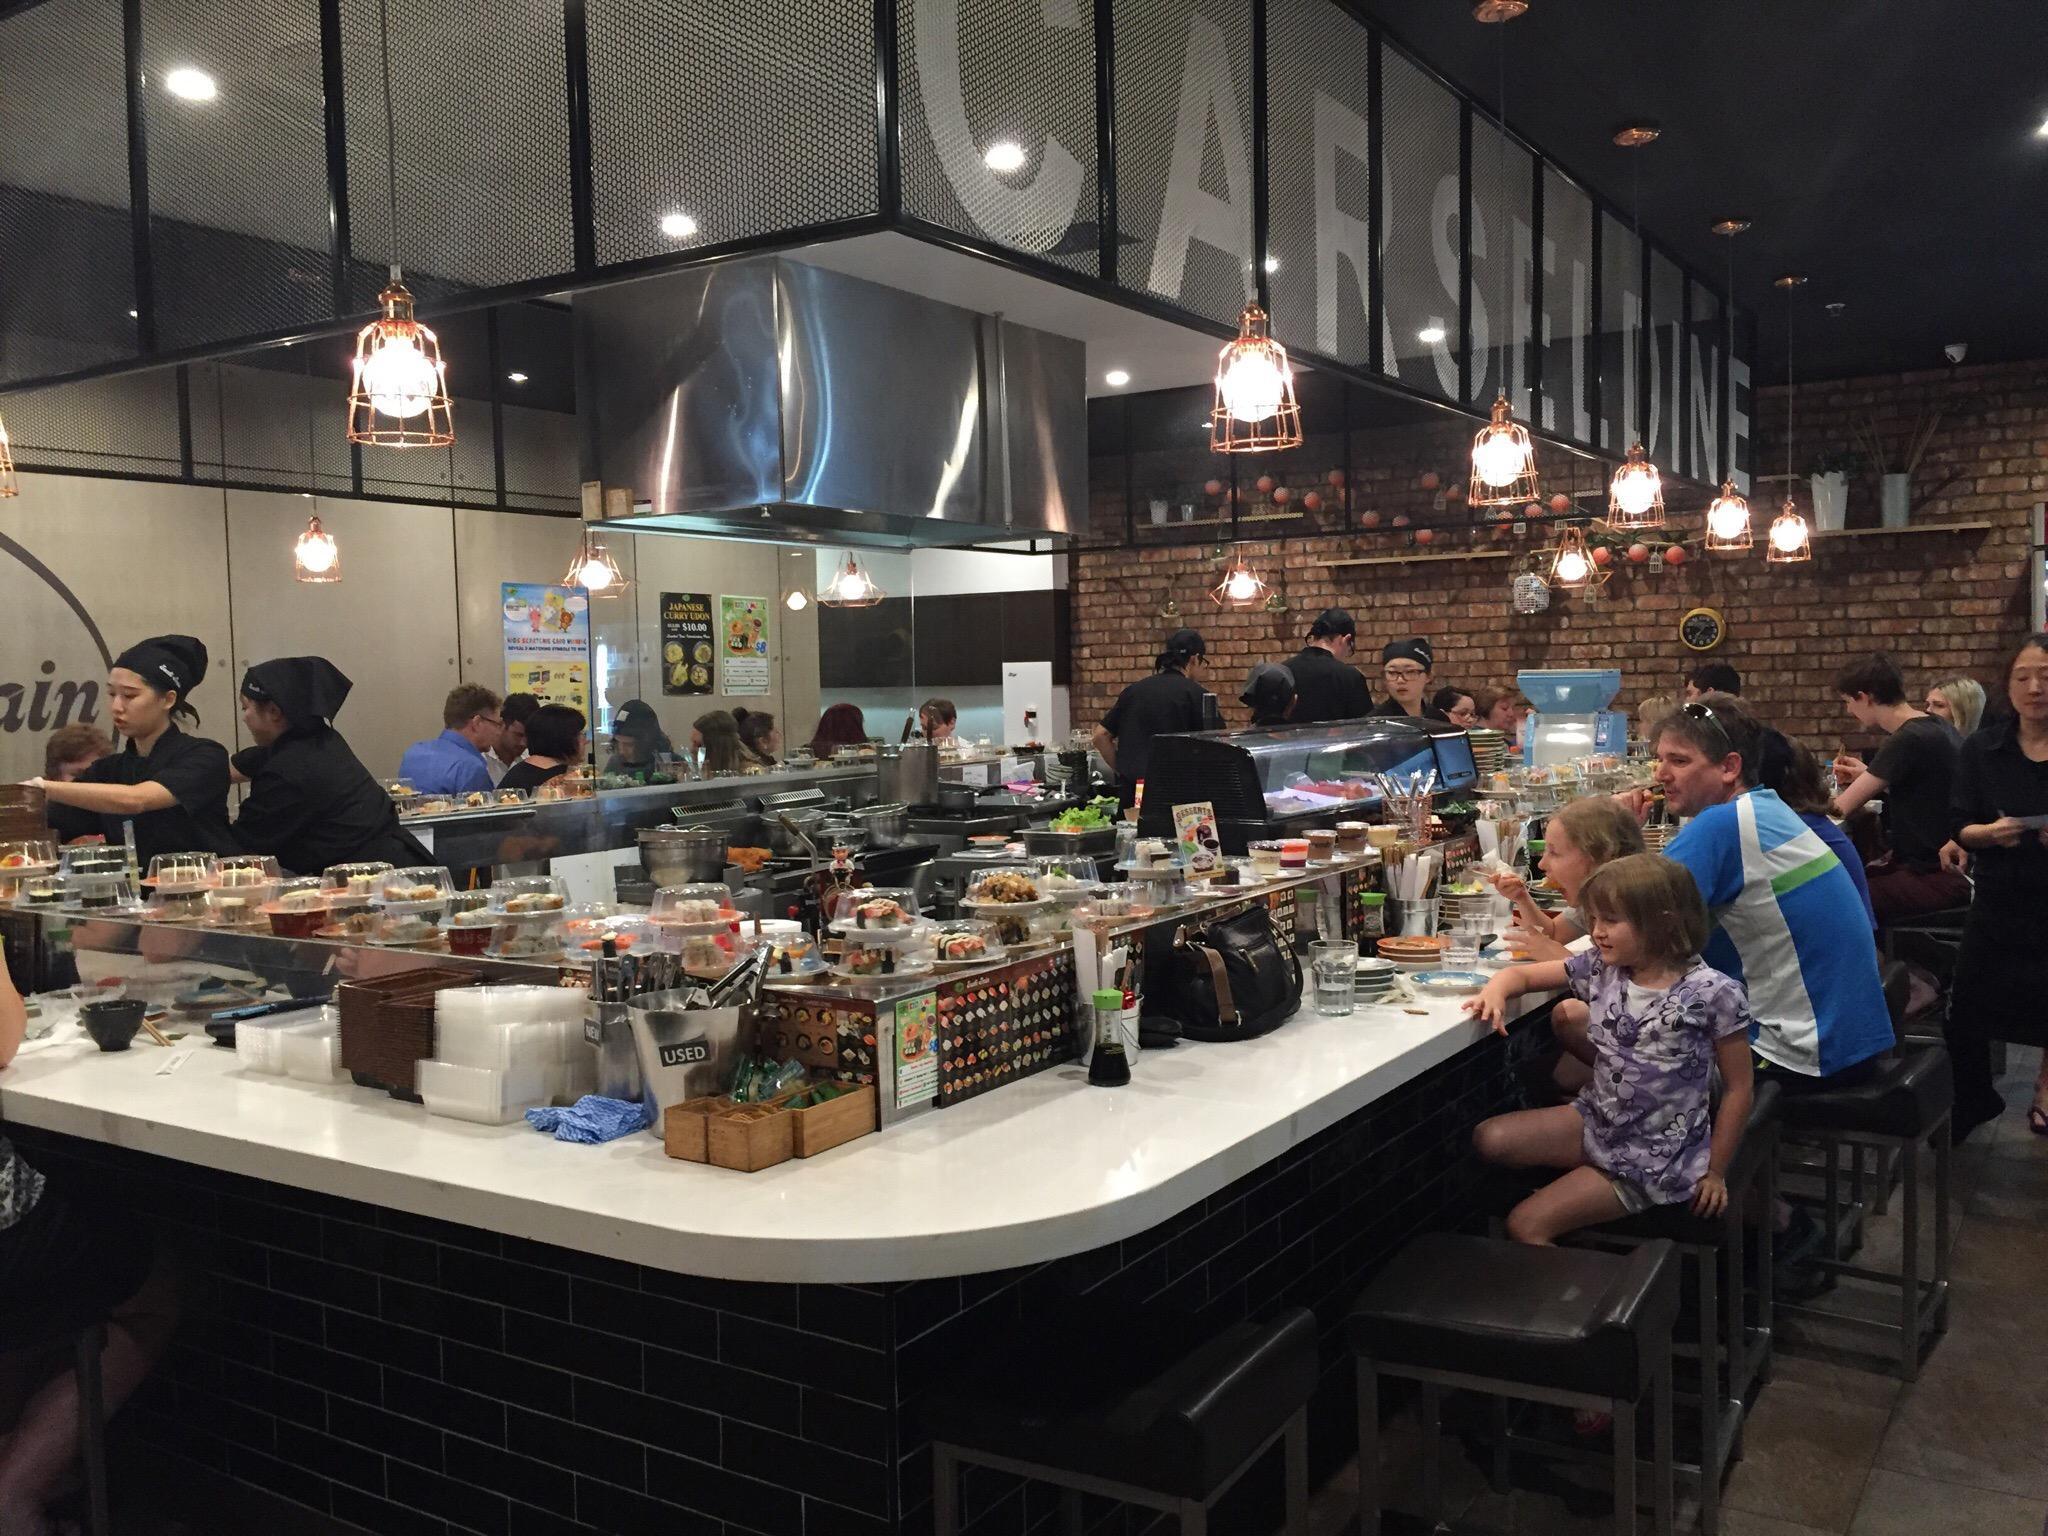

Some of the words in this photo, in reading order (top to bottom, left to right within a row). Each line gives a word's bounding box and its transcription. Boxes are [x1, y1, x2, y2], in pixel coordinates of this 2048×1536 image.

[913, 0, 1750, 497] CARSELDINE
[669, 603, 704, 611] JAPANESE
[663, 612, 688, 620] CURRY
[690, 612, 710, 620] UDON
[682, 623, 708, 632] $10.00
[756, 641, 767, 654] $8
[1176, 806, 1213, 819] DESSERTS
[664, 1046, 706, 1064] USED
